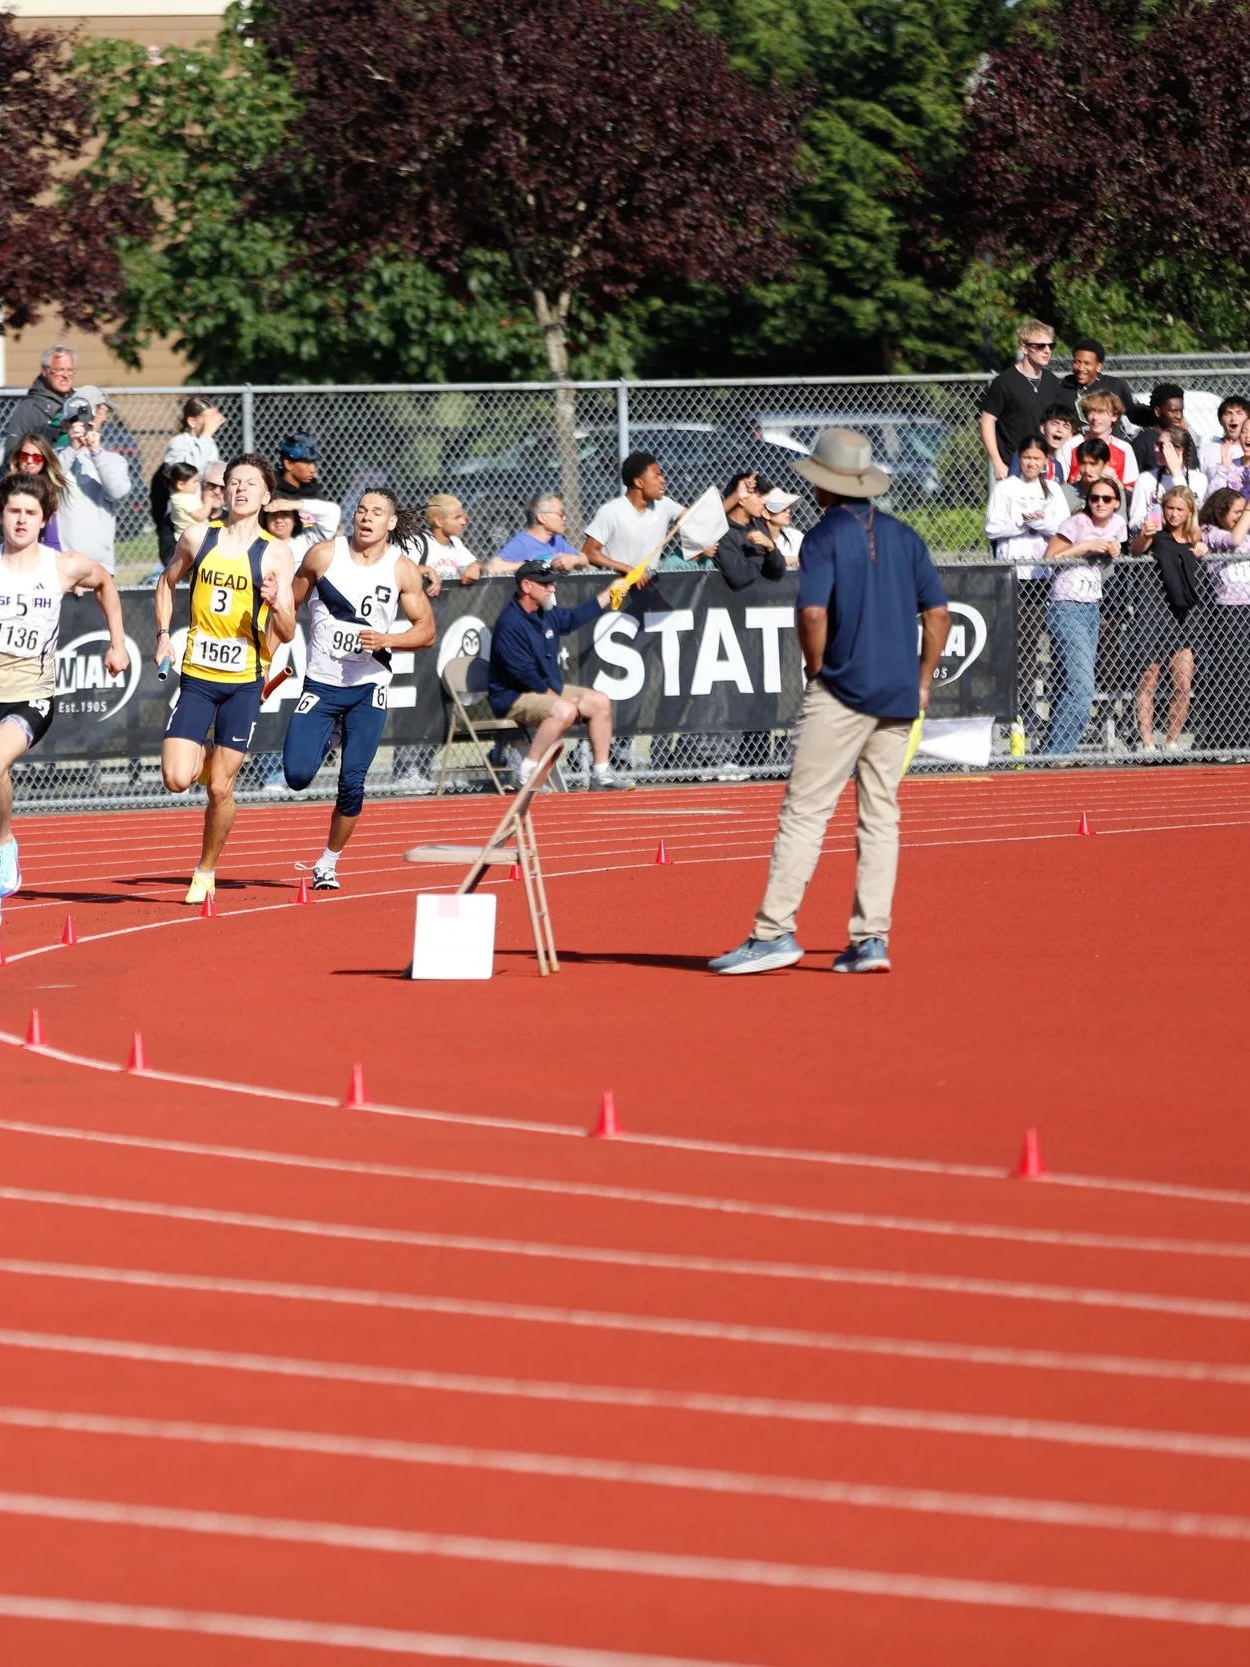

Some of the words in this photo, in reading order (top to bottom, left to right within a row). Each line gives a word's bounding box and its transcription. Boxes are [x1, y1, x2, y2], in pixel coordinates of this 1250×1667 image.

[200, 568, 248, 591] MEAD
[16, 593, 28, 617] 5
[214, 590, 228, 613] 3
[360, 595, 373, 617] 6
[375, 585, 391, 604] G
[200, 641, 242, 664] 1562
[592, 608, 806, 700] STAT
[298, 694, 315, 712] 6
